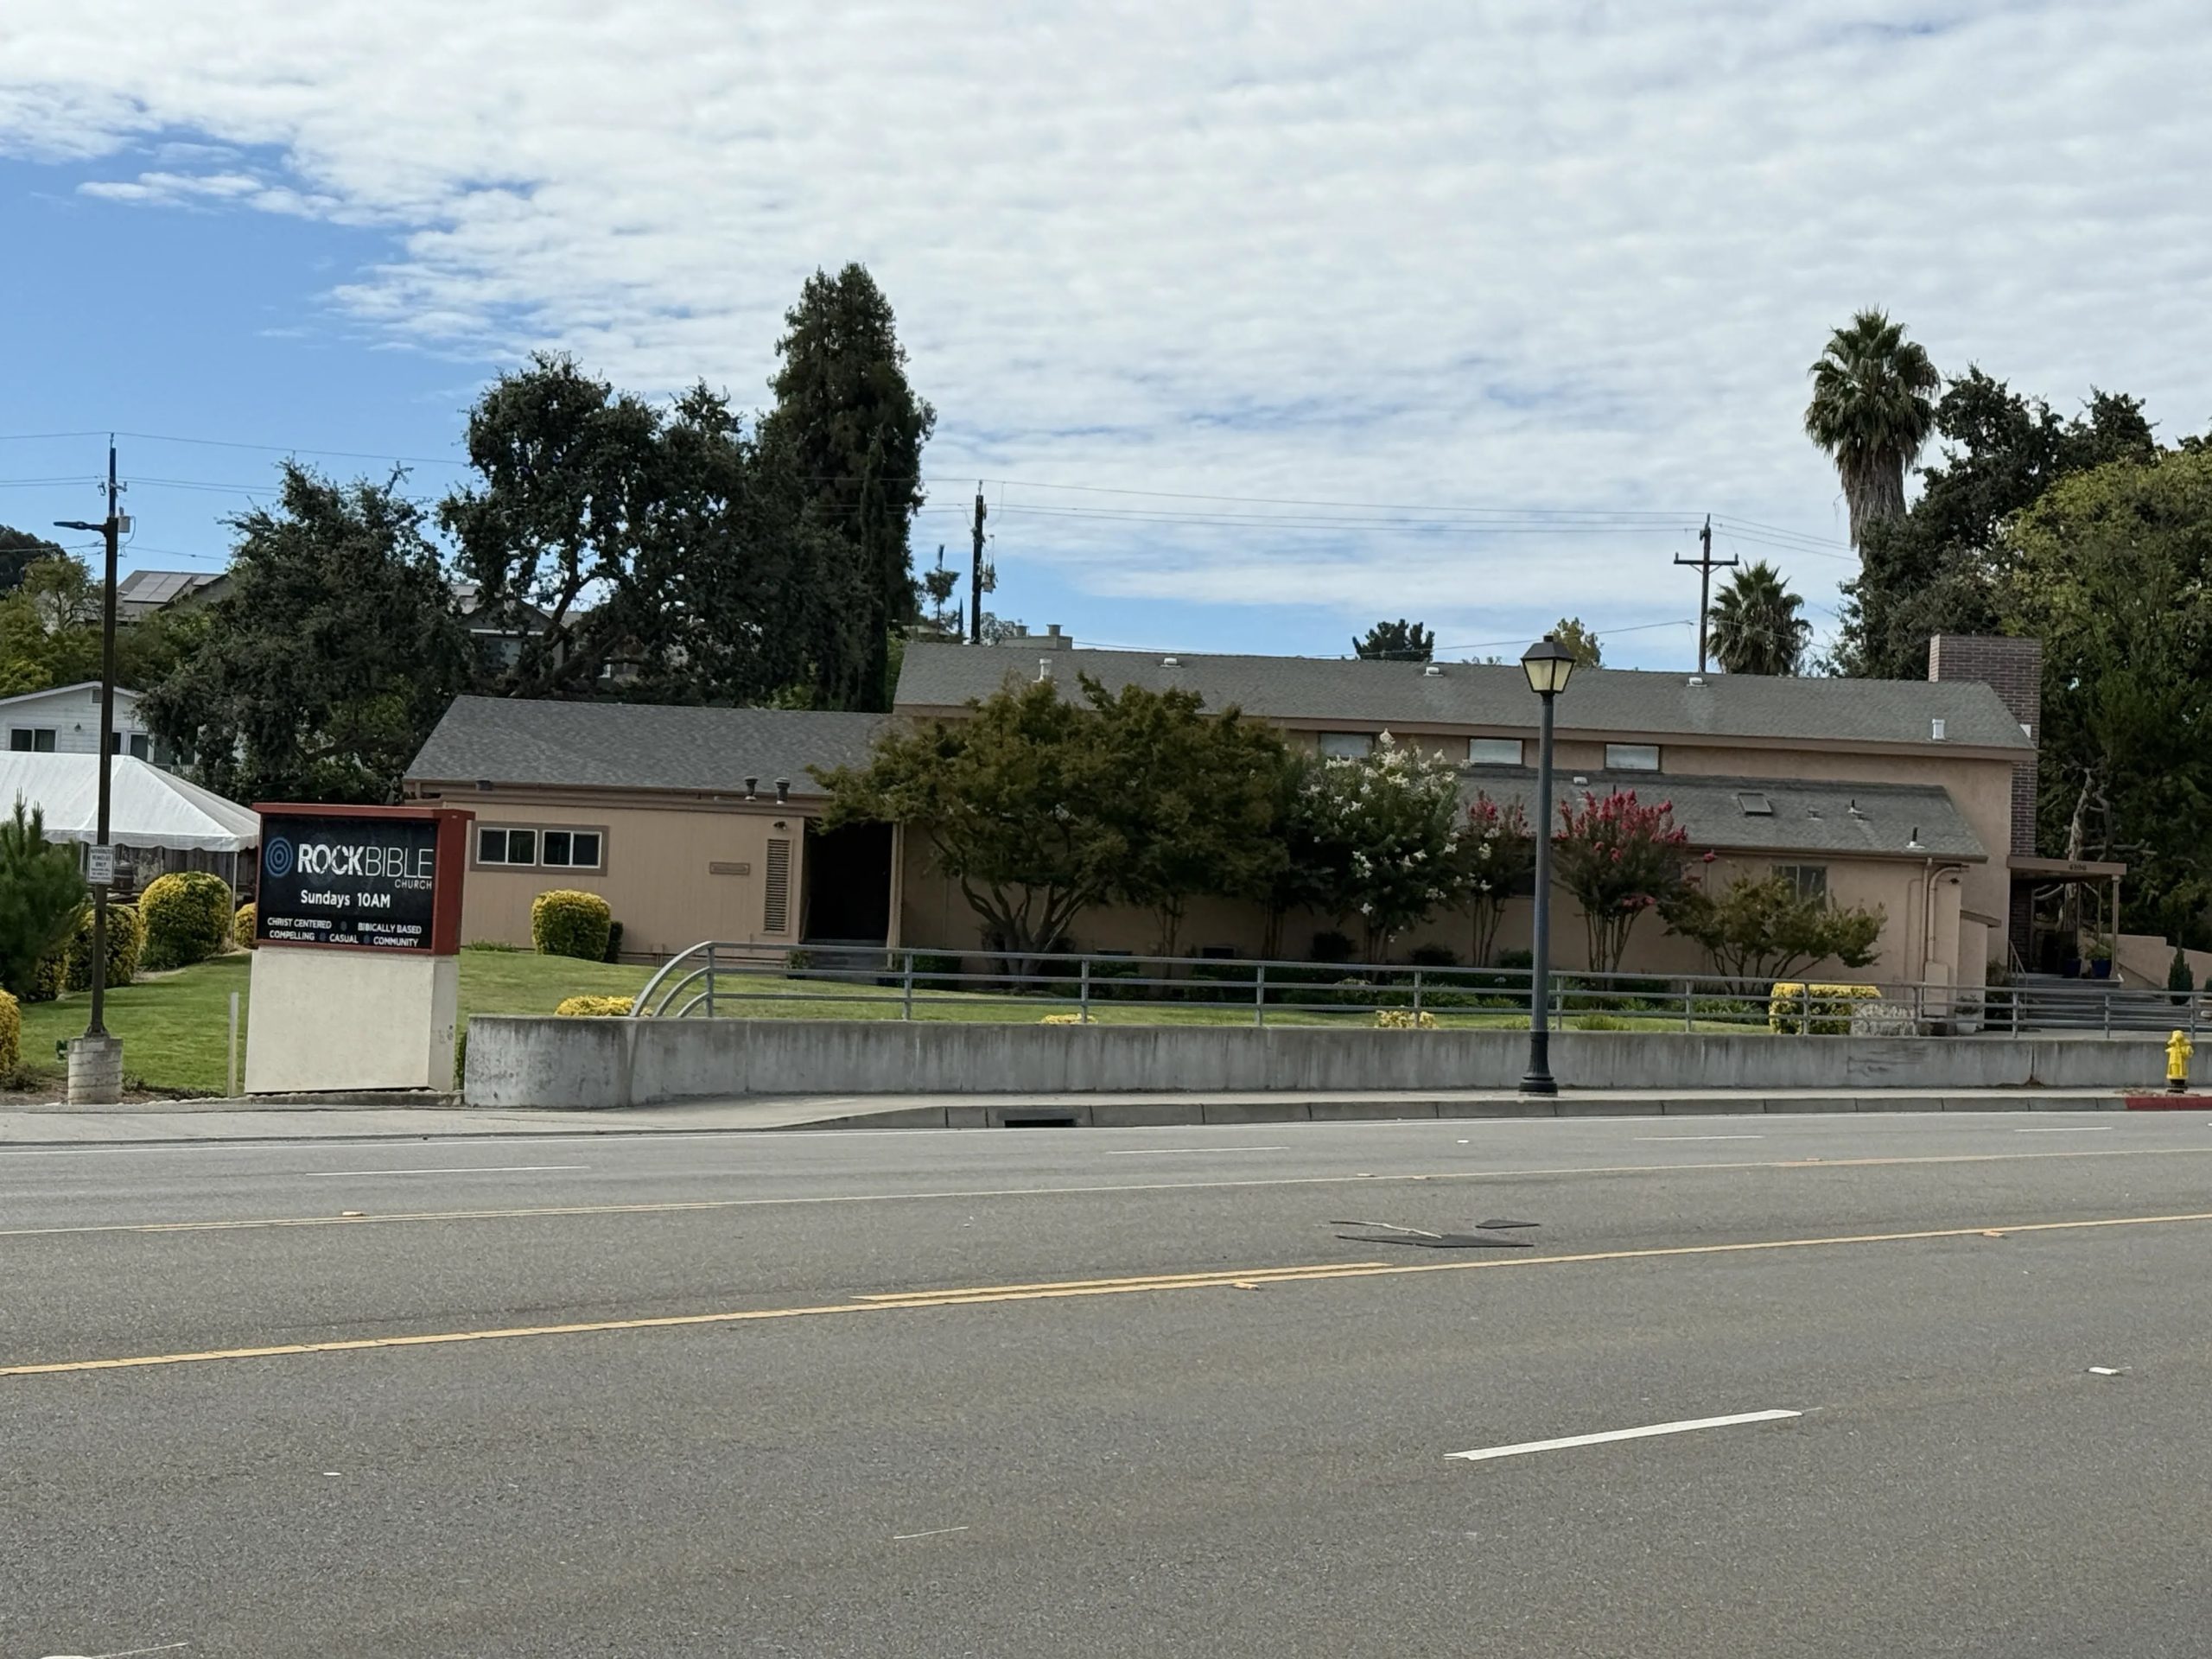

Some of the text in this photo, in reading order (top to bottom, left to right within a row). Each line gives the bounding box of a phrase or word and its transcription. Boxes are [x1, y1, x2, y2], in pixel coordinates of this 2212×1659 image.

[394, 879, 432, 890] CHURCH
[301, 890, 391, 909] Sundays 10AM
[267, 917, 332, 929] CHRIST CENTERED
[397, 925, 422, 934] BASED
[269, 930, 315, 941] COMPELLING
[329, 933, 359, 944] CASUAL
[373, 936, 419, 947] COMMUNITY
